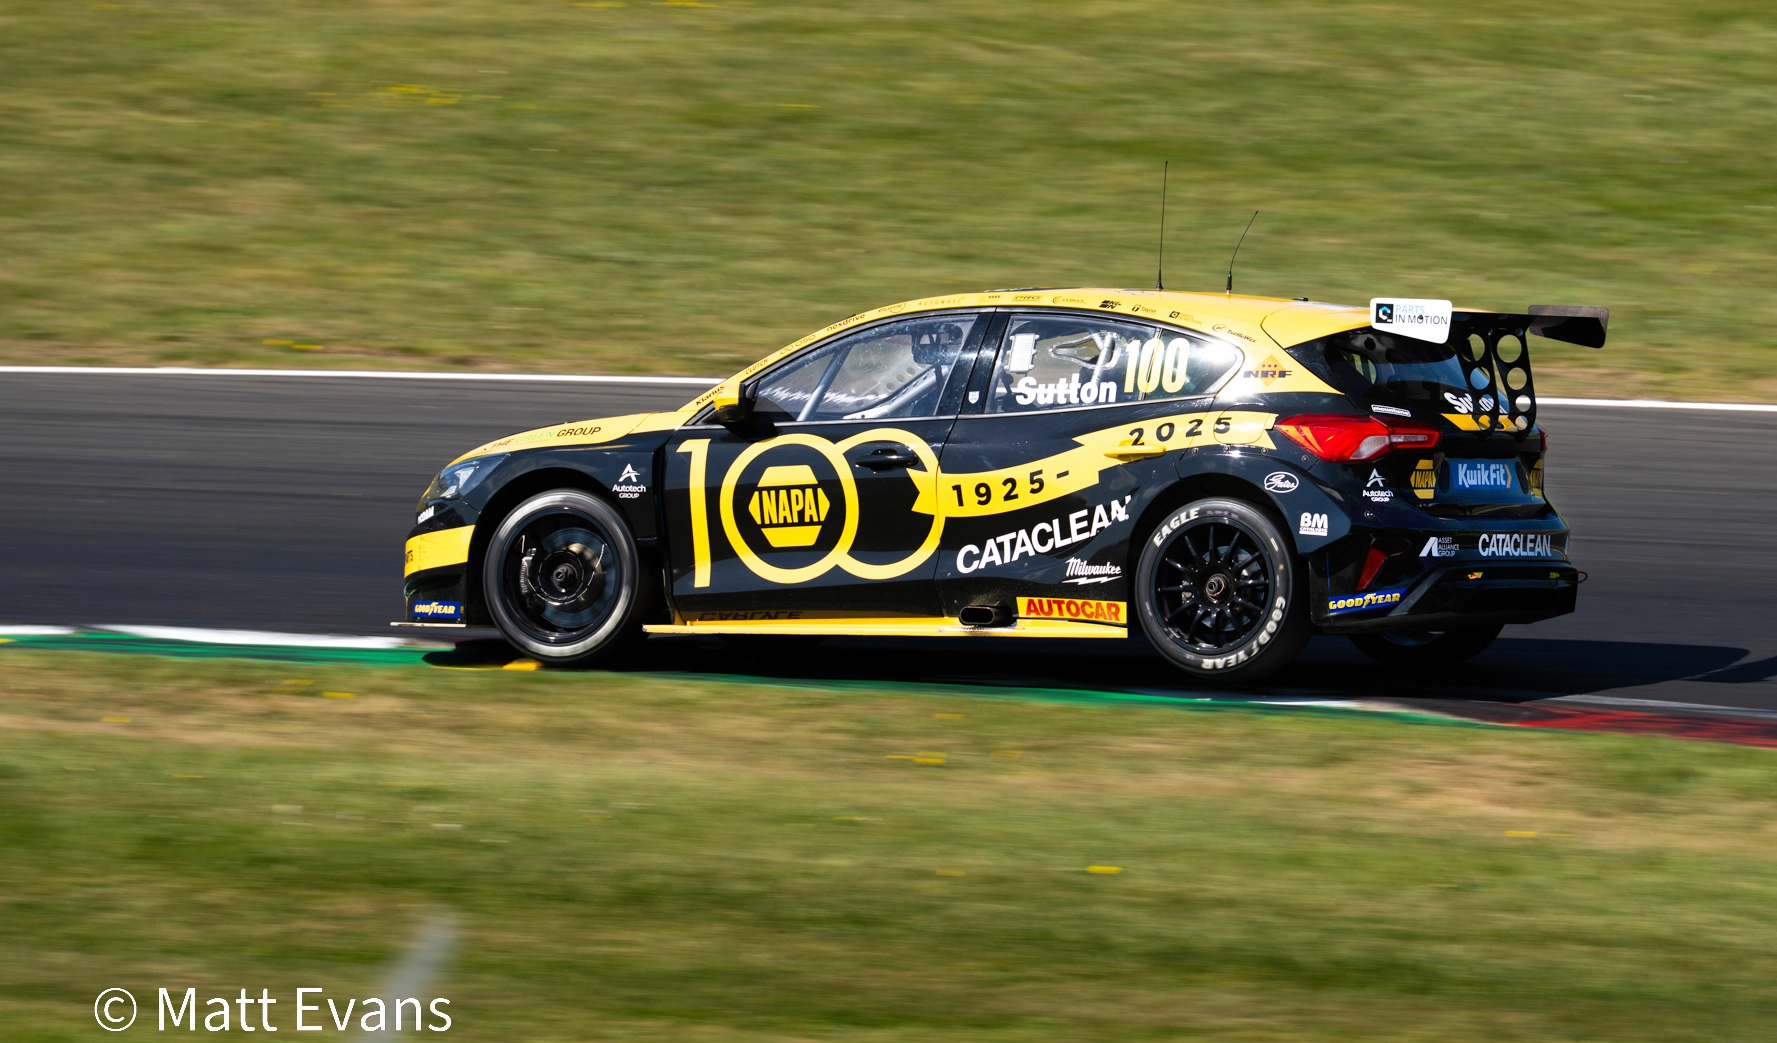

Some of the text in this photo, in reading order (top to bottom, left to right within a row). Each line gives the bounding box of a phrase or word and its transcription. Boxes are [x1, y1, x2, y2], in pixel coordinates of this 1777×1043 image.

[1395, 304, 1425, 314] PARTS
[1395, 314, 1448, 325] IN MOTION
[1123, 338, 1191, 394] 100
[1243, 370, 1293, 379] NRF
[1015, 374, 1118, 406] Sutton
[556, 426, 602, 437] GROUP
[1129, 416, 1233, 446] 2025
[612, 484, 647, 492] Autotech
[1415, 470, 1434, 488] NAPA
[1362, 489, 1394, 497] Autotech
[762, 488, 821, 524] NAPA
[1152, 507, 1200, 548] EAGLE
[1300, 512, 1328, 528] BM
[956, 495, 1132, 574] CATACLEAN
[1478, 533, 1552, 557] CATACLEAN
[1065, 556, 1122, 577] Milwaukee
[414, 602, 456, 616] GOODYEAR
[1025, 598, 1121, 622] AUTOCAR
[1327, 592, 1401, 609] GOODYEAR
[1200, 595, 1287, 670] GOODYEAR
